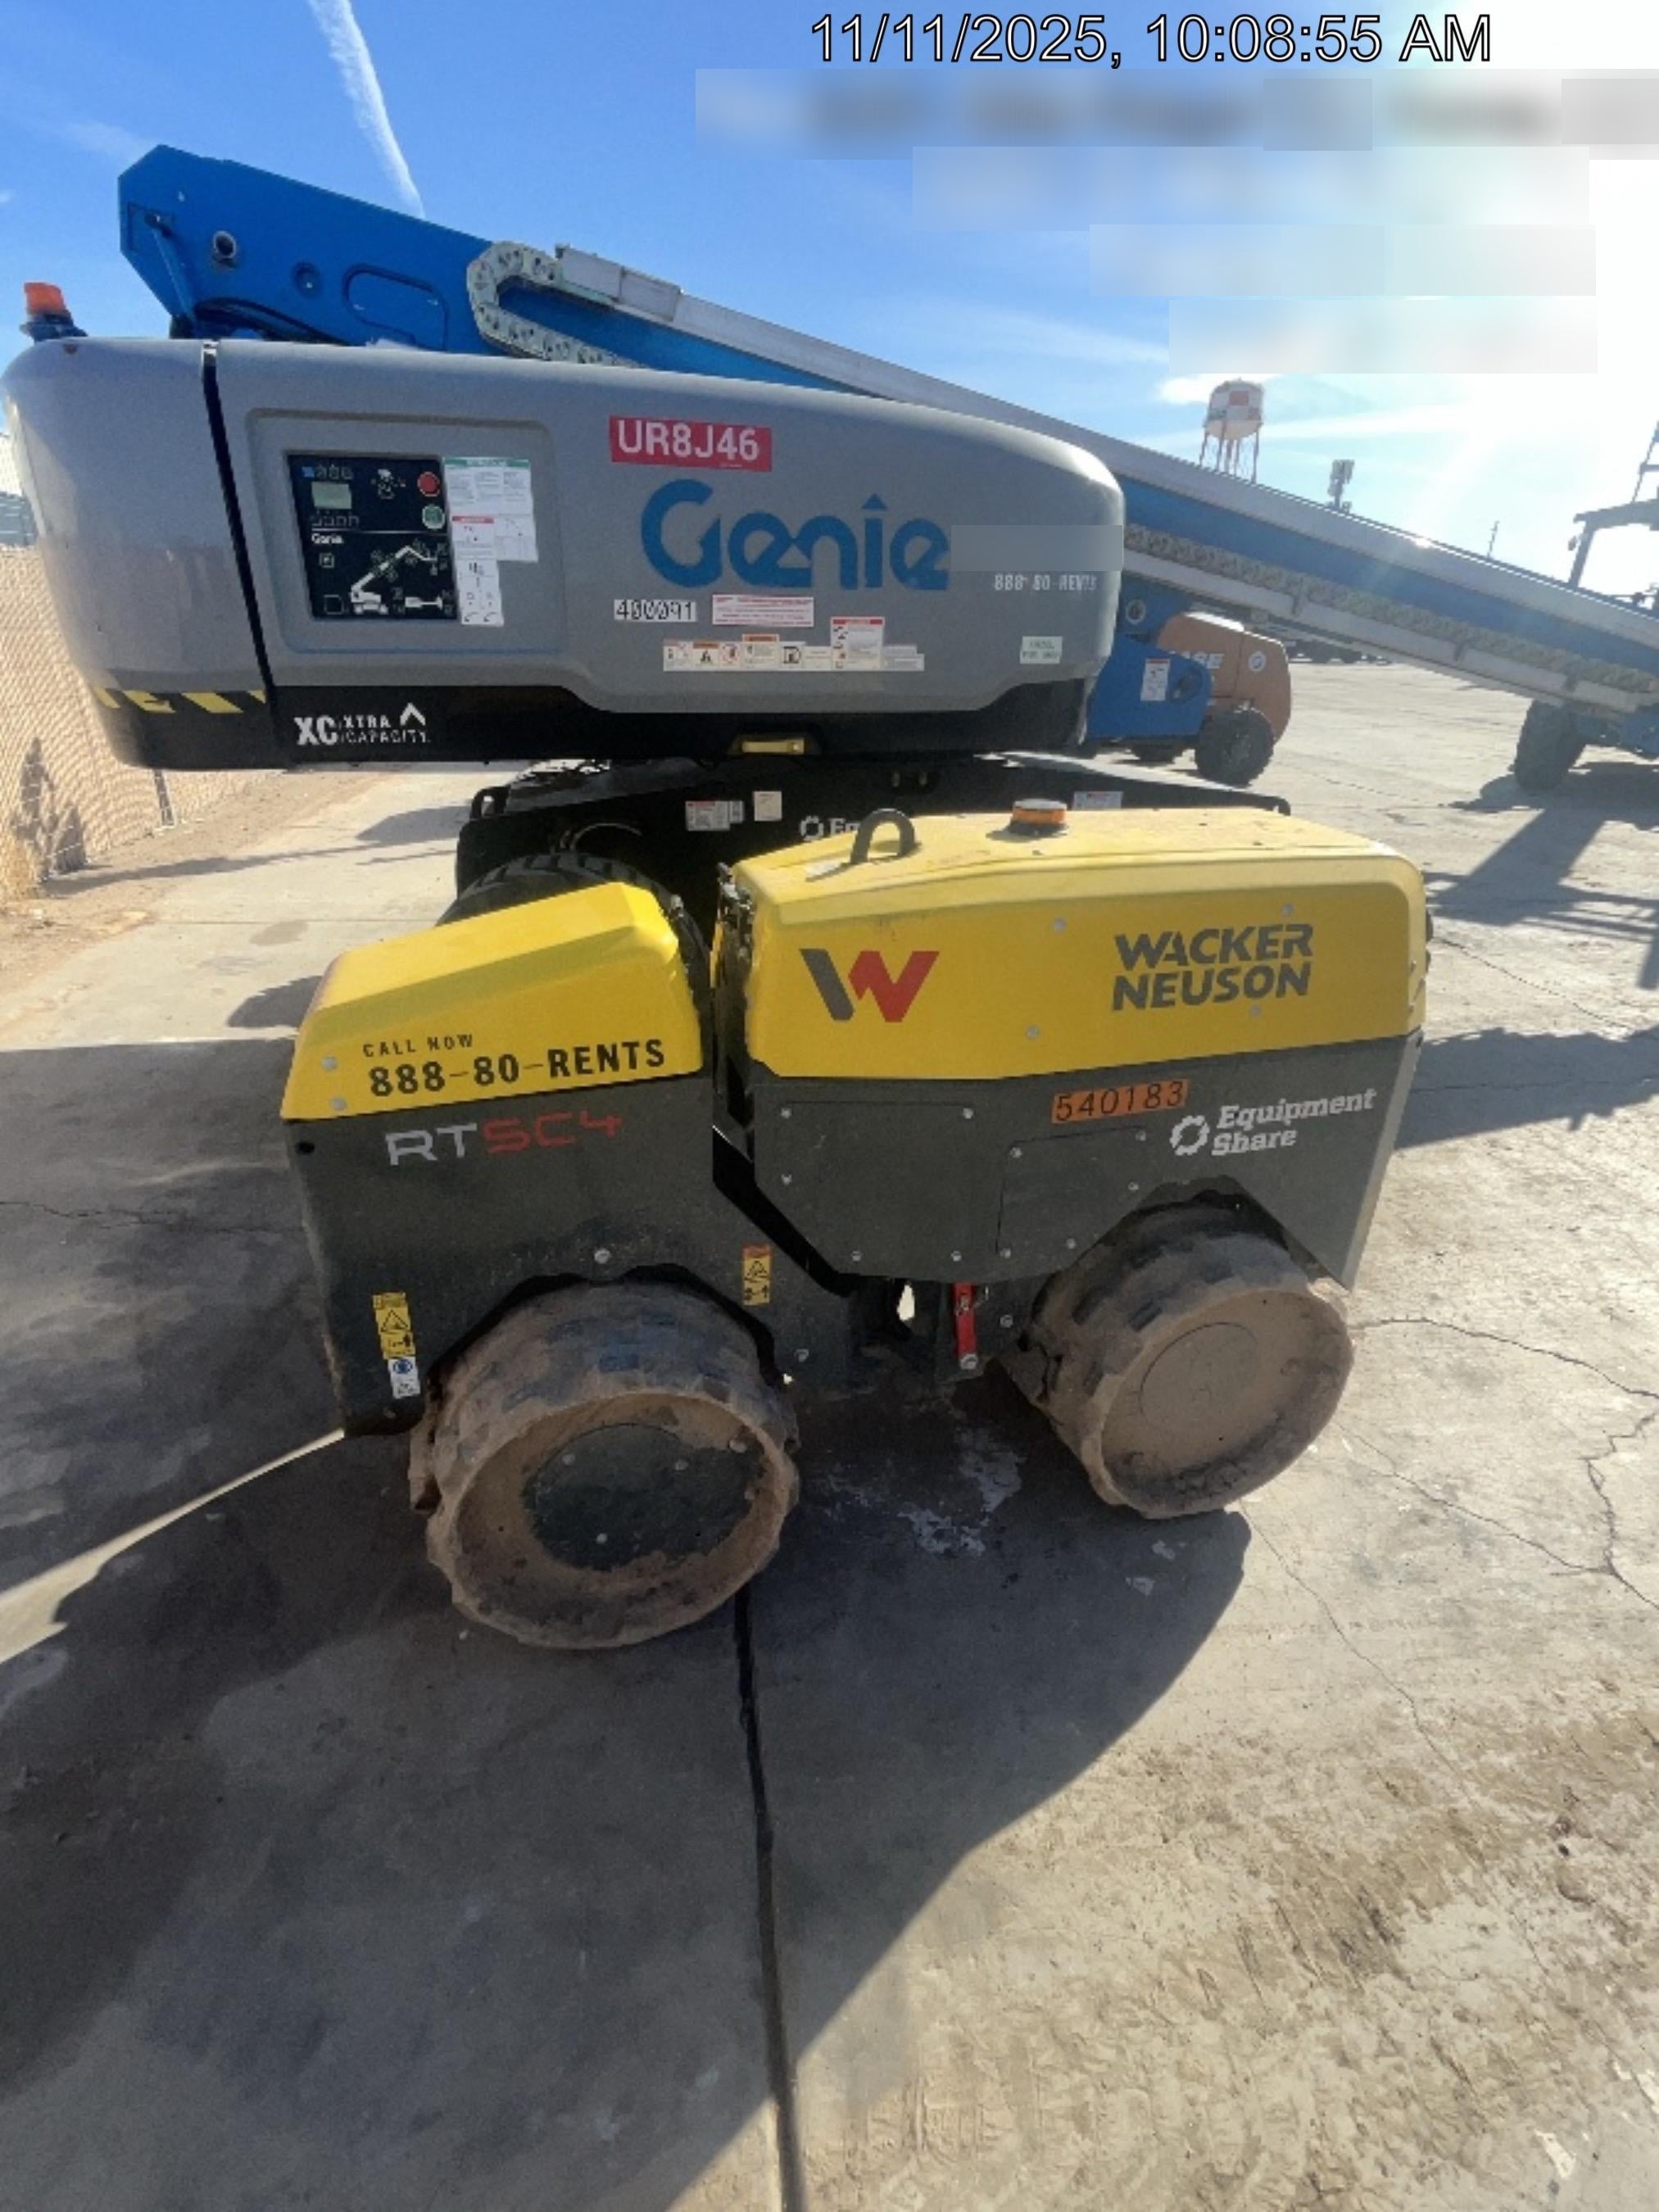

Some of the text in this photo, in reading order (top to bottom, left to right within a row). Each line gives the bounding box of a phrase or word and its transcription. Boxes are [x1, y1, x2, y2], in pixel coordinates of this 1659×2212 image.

[618, 419, 760, 461] UR8J46
[641, 478, 950, 591] Genie
[293, 714, 338, 746] XC
[343, 714, 392, 728] XTRA
[346, 729, 426, 743] CAPACITY
[1113, 922, 1314, 971] WACKER
[1111, 962, 1312, 1011] NEUSON
[363, 1034, 474, 1058] CALL NOW
[369, 1038, 665, 1097] 888-80-RENTS
[1054, 1081, 1185, 1122] 540183
[1216, 1087, 1377, 1130] Equipment
[1210, 1127, 1298, 1157] Share
